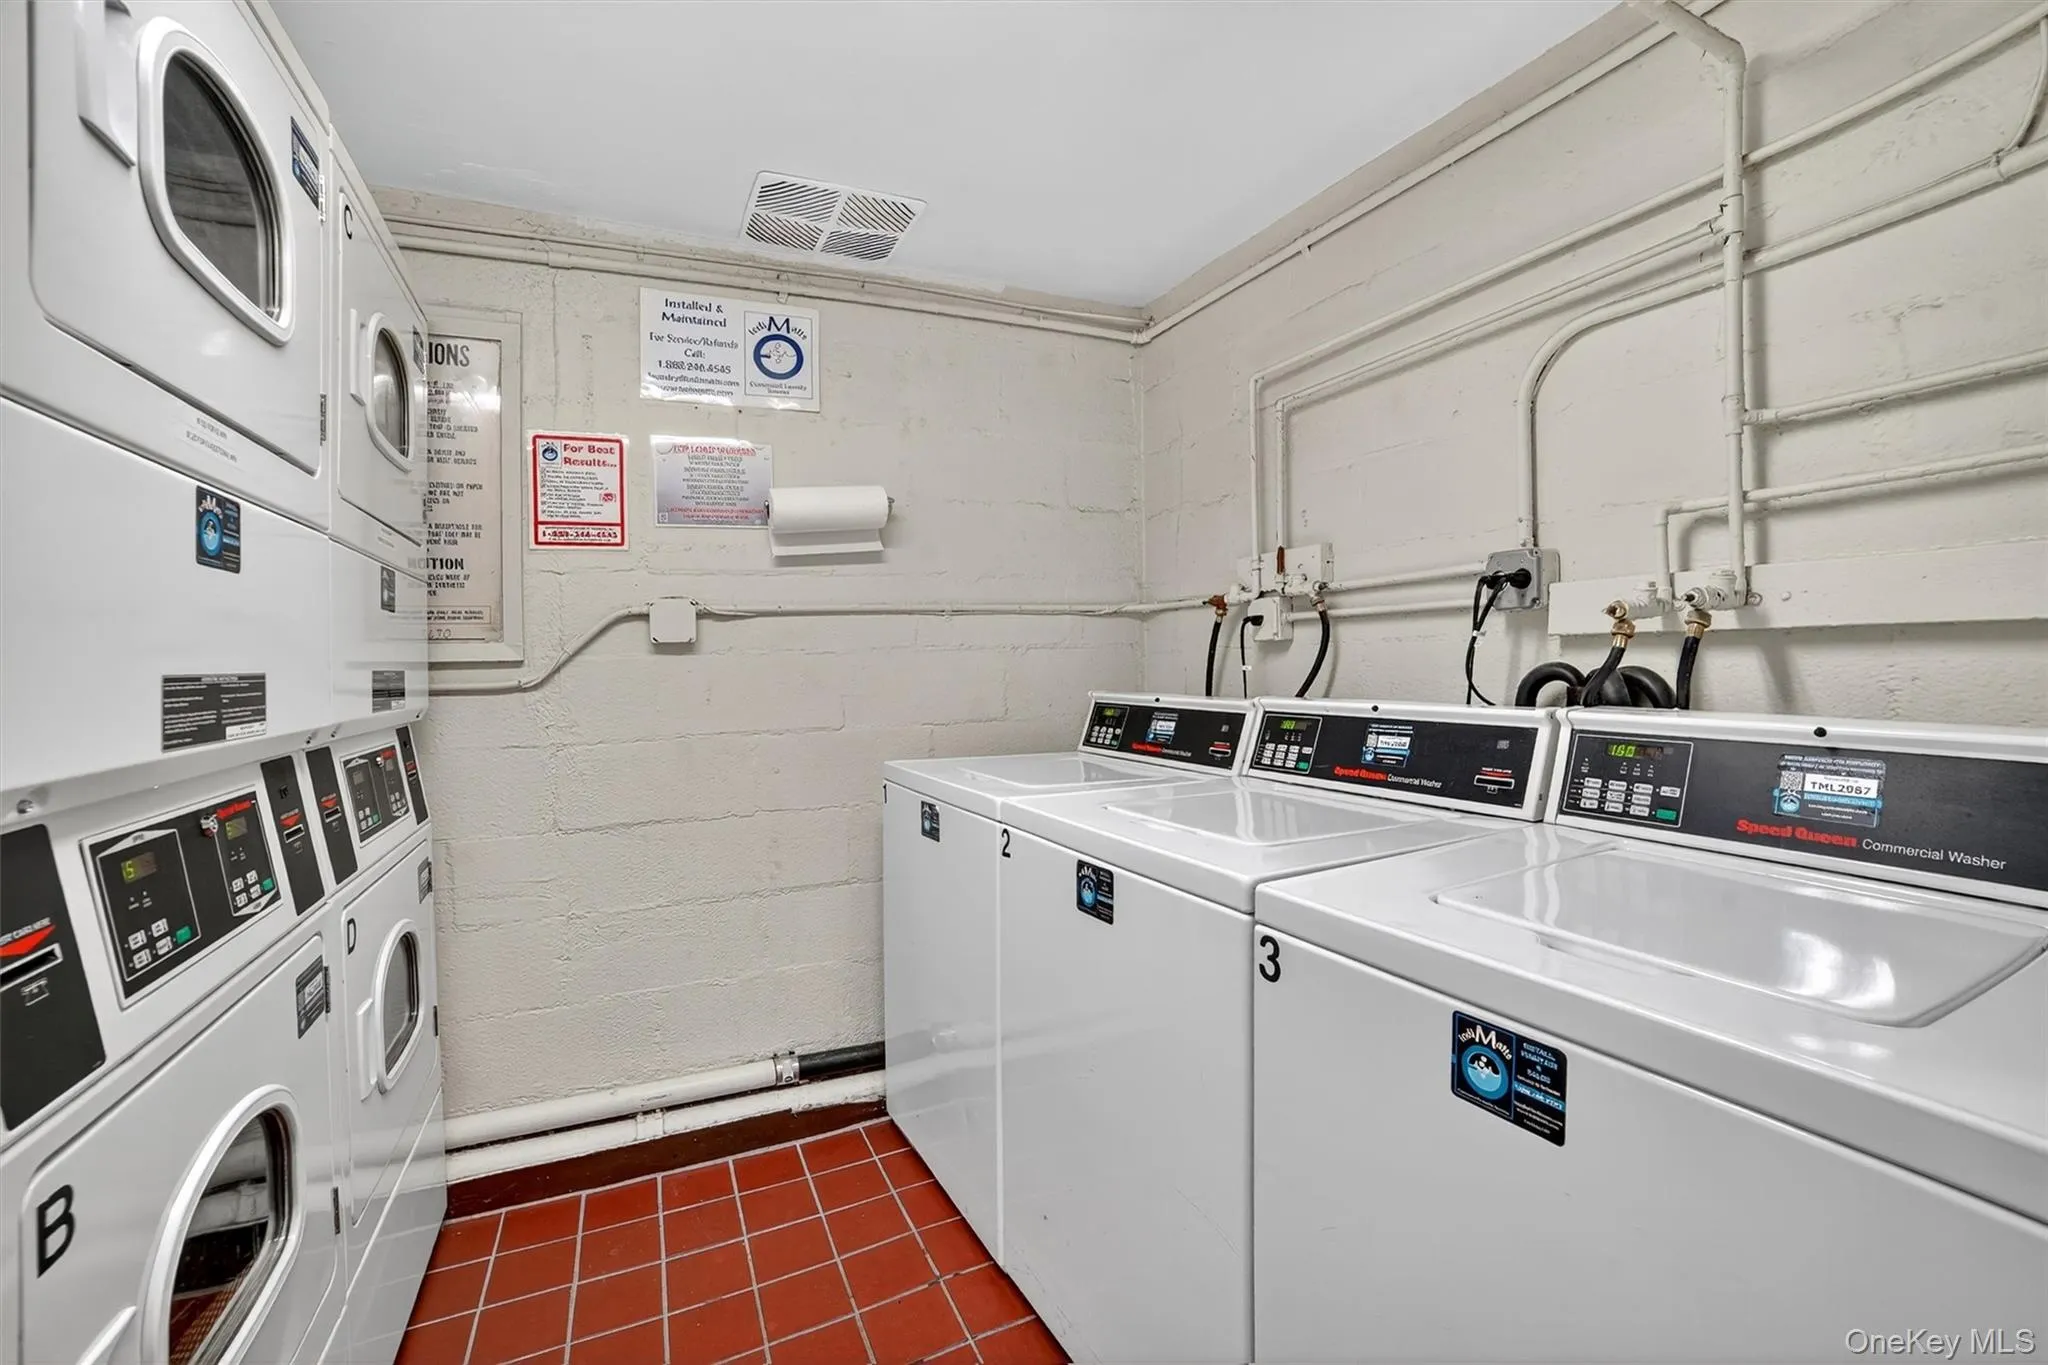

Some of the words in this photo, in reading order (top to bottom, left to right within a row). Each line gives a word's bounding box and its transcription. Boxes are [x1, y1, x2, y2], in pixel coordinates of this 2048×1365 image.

[344, 204, 353, 240] C
[662, 312, 727, 328] Maintained
[665, 298, 711, 313] Installed
[711, 304, 724, 313] &
[563, 443, 583, 454] For
[588, 445, 616, 455] Best
[882, 784, 887, 804] 1
[1001, 828, 1011, 858] 2
[1736, 819, 1792, 840] Speed
[1794, 827, 1858, 848] Queen
[1862, 839, 1944, 861] Commercial
[1948, 850, 2006, 871] Washer
[347, 917, 357, 955] D
[1259, 935, 1281, 983] 3
[37, 1184, 76, 1279] B
